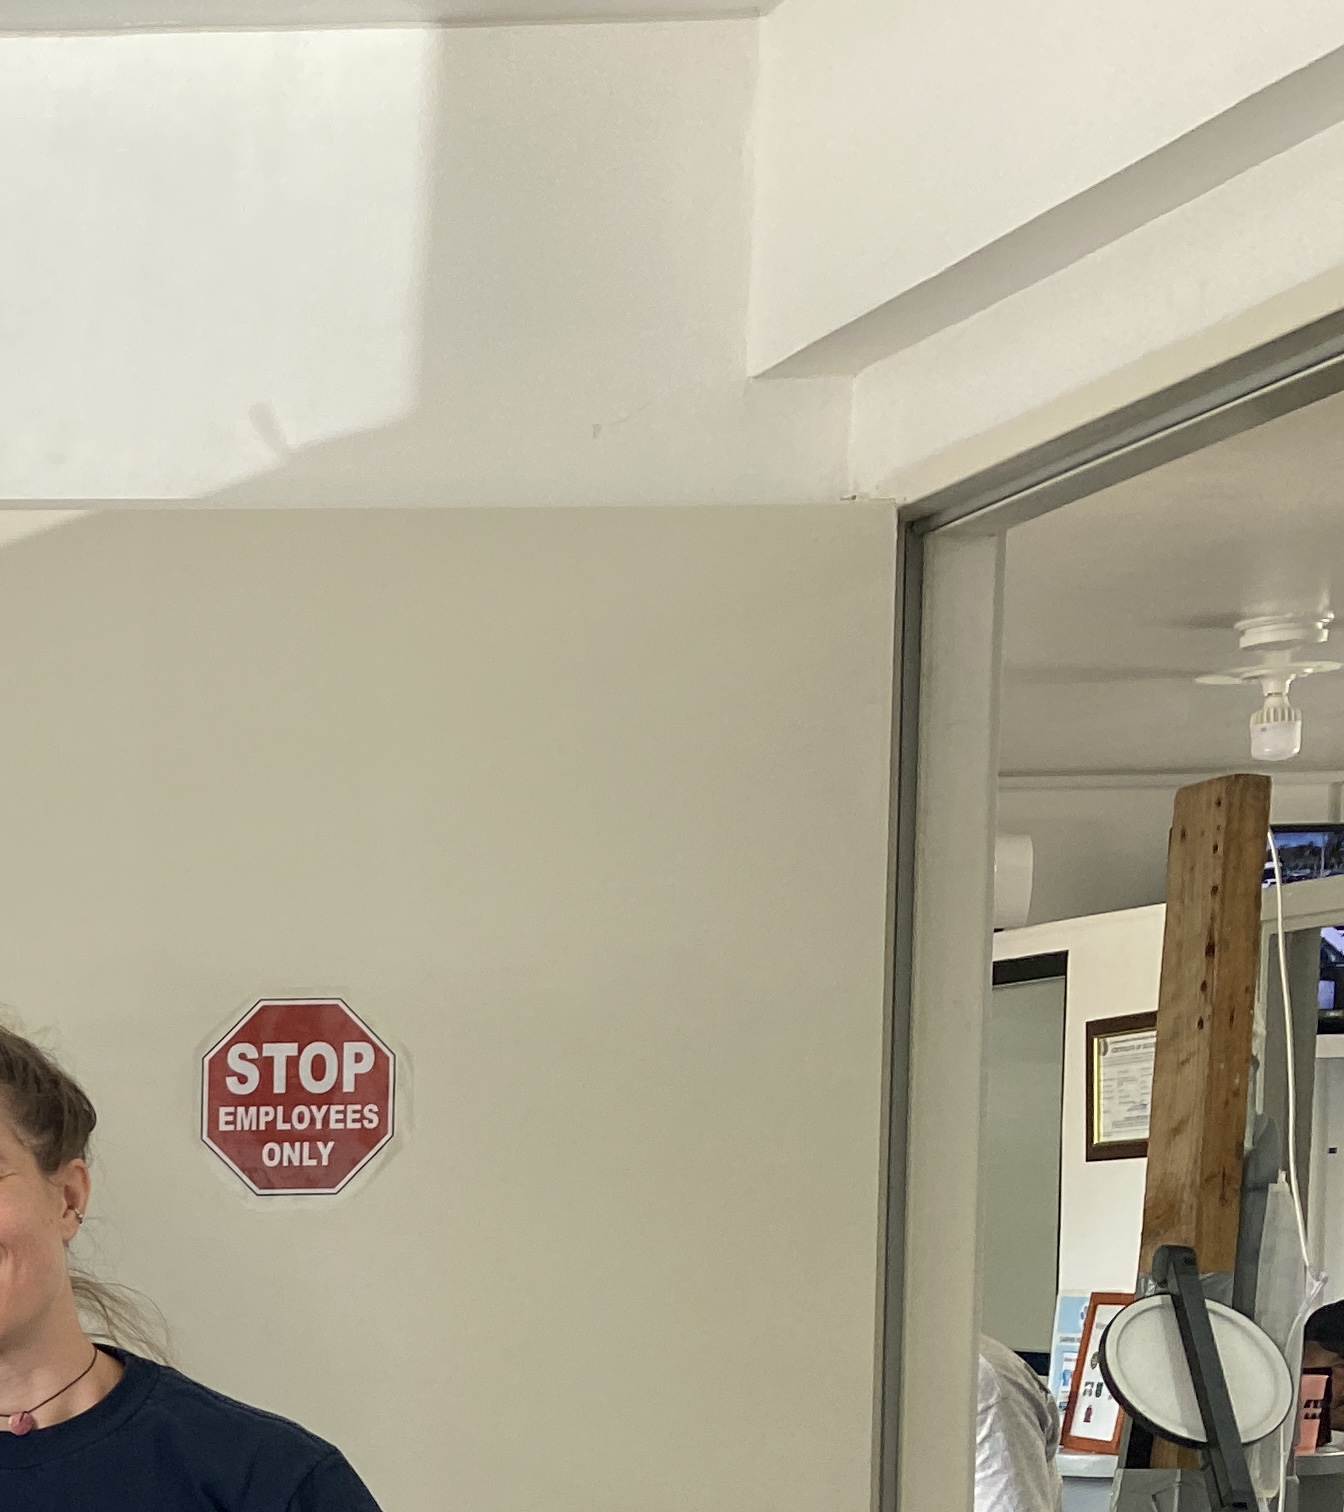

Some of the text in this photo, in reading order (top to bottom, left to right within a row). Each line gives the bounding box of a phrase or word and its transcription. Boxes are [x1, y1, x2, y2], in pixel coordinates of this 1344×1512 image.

[225, 1041, 375, 1095] STOP
[218, 1104, 380, 1131] EMPLOYEES
[261, 1141, 335, 1167] ONLY
